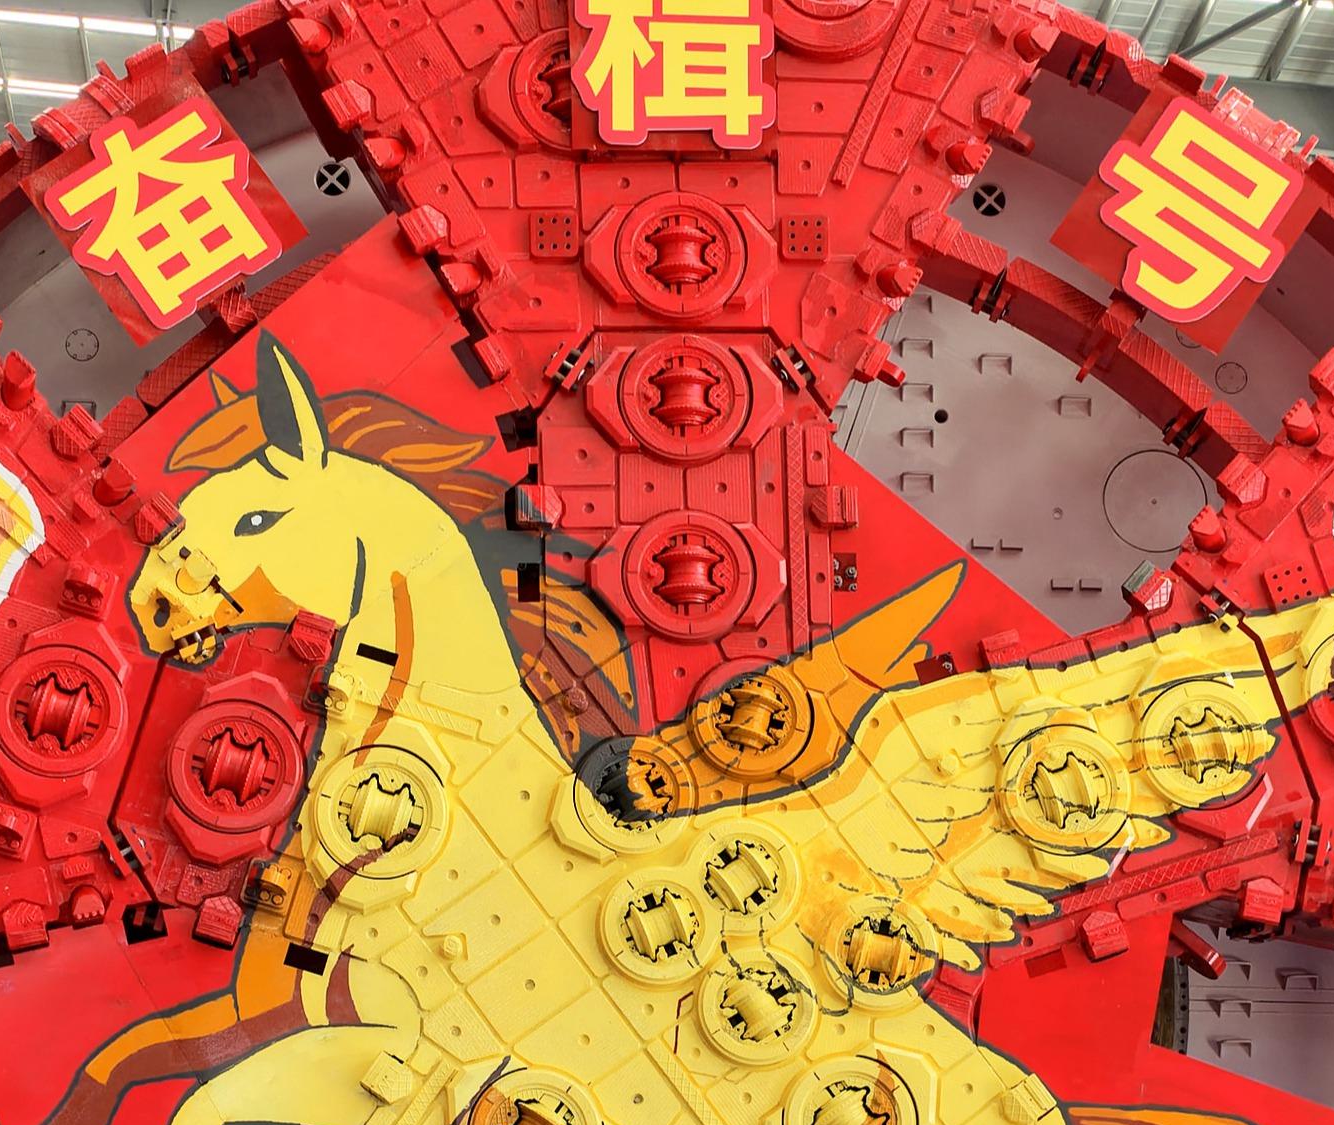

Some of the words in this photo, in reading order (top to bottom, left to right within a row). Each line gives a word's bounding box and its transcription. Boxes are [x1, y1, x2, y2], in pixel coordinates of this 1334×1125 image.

[58, 110, 273, 317] 奋
[586, 0, 764, 136] 楫
[1114, 109, 1295, 312] 号
